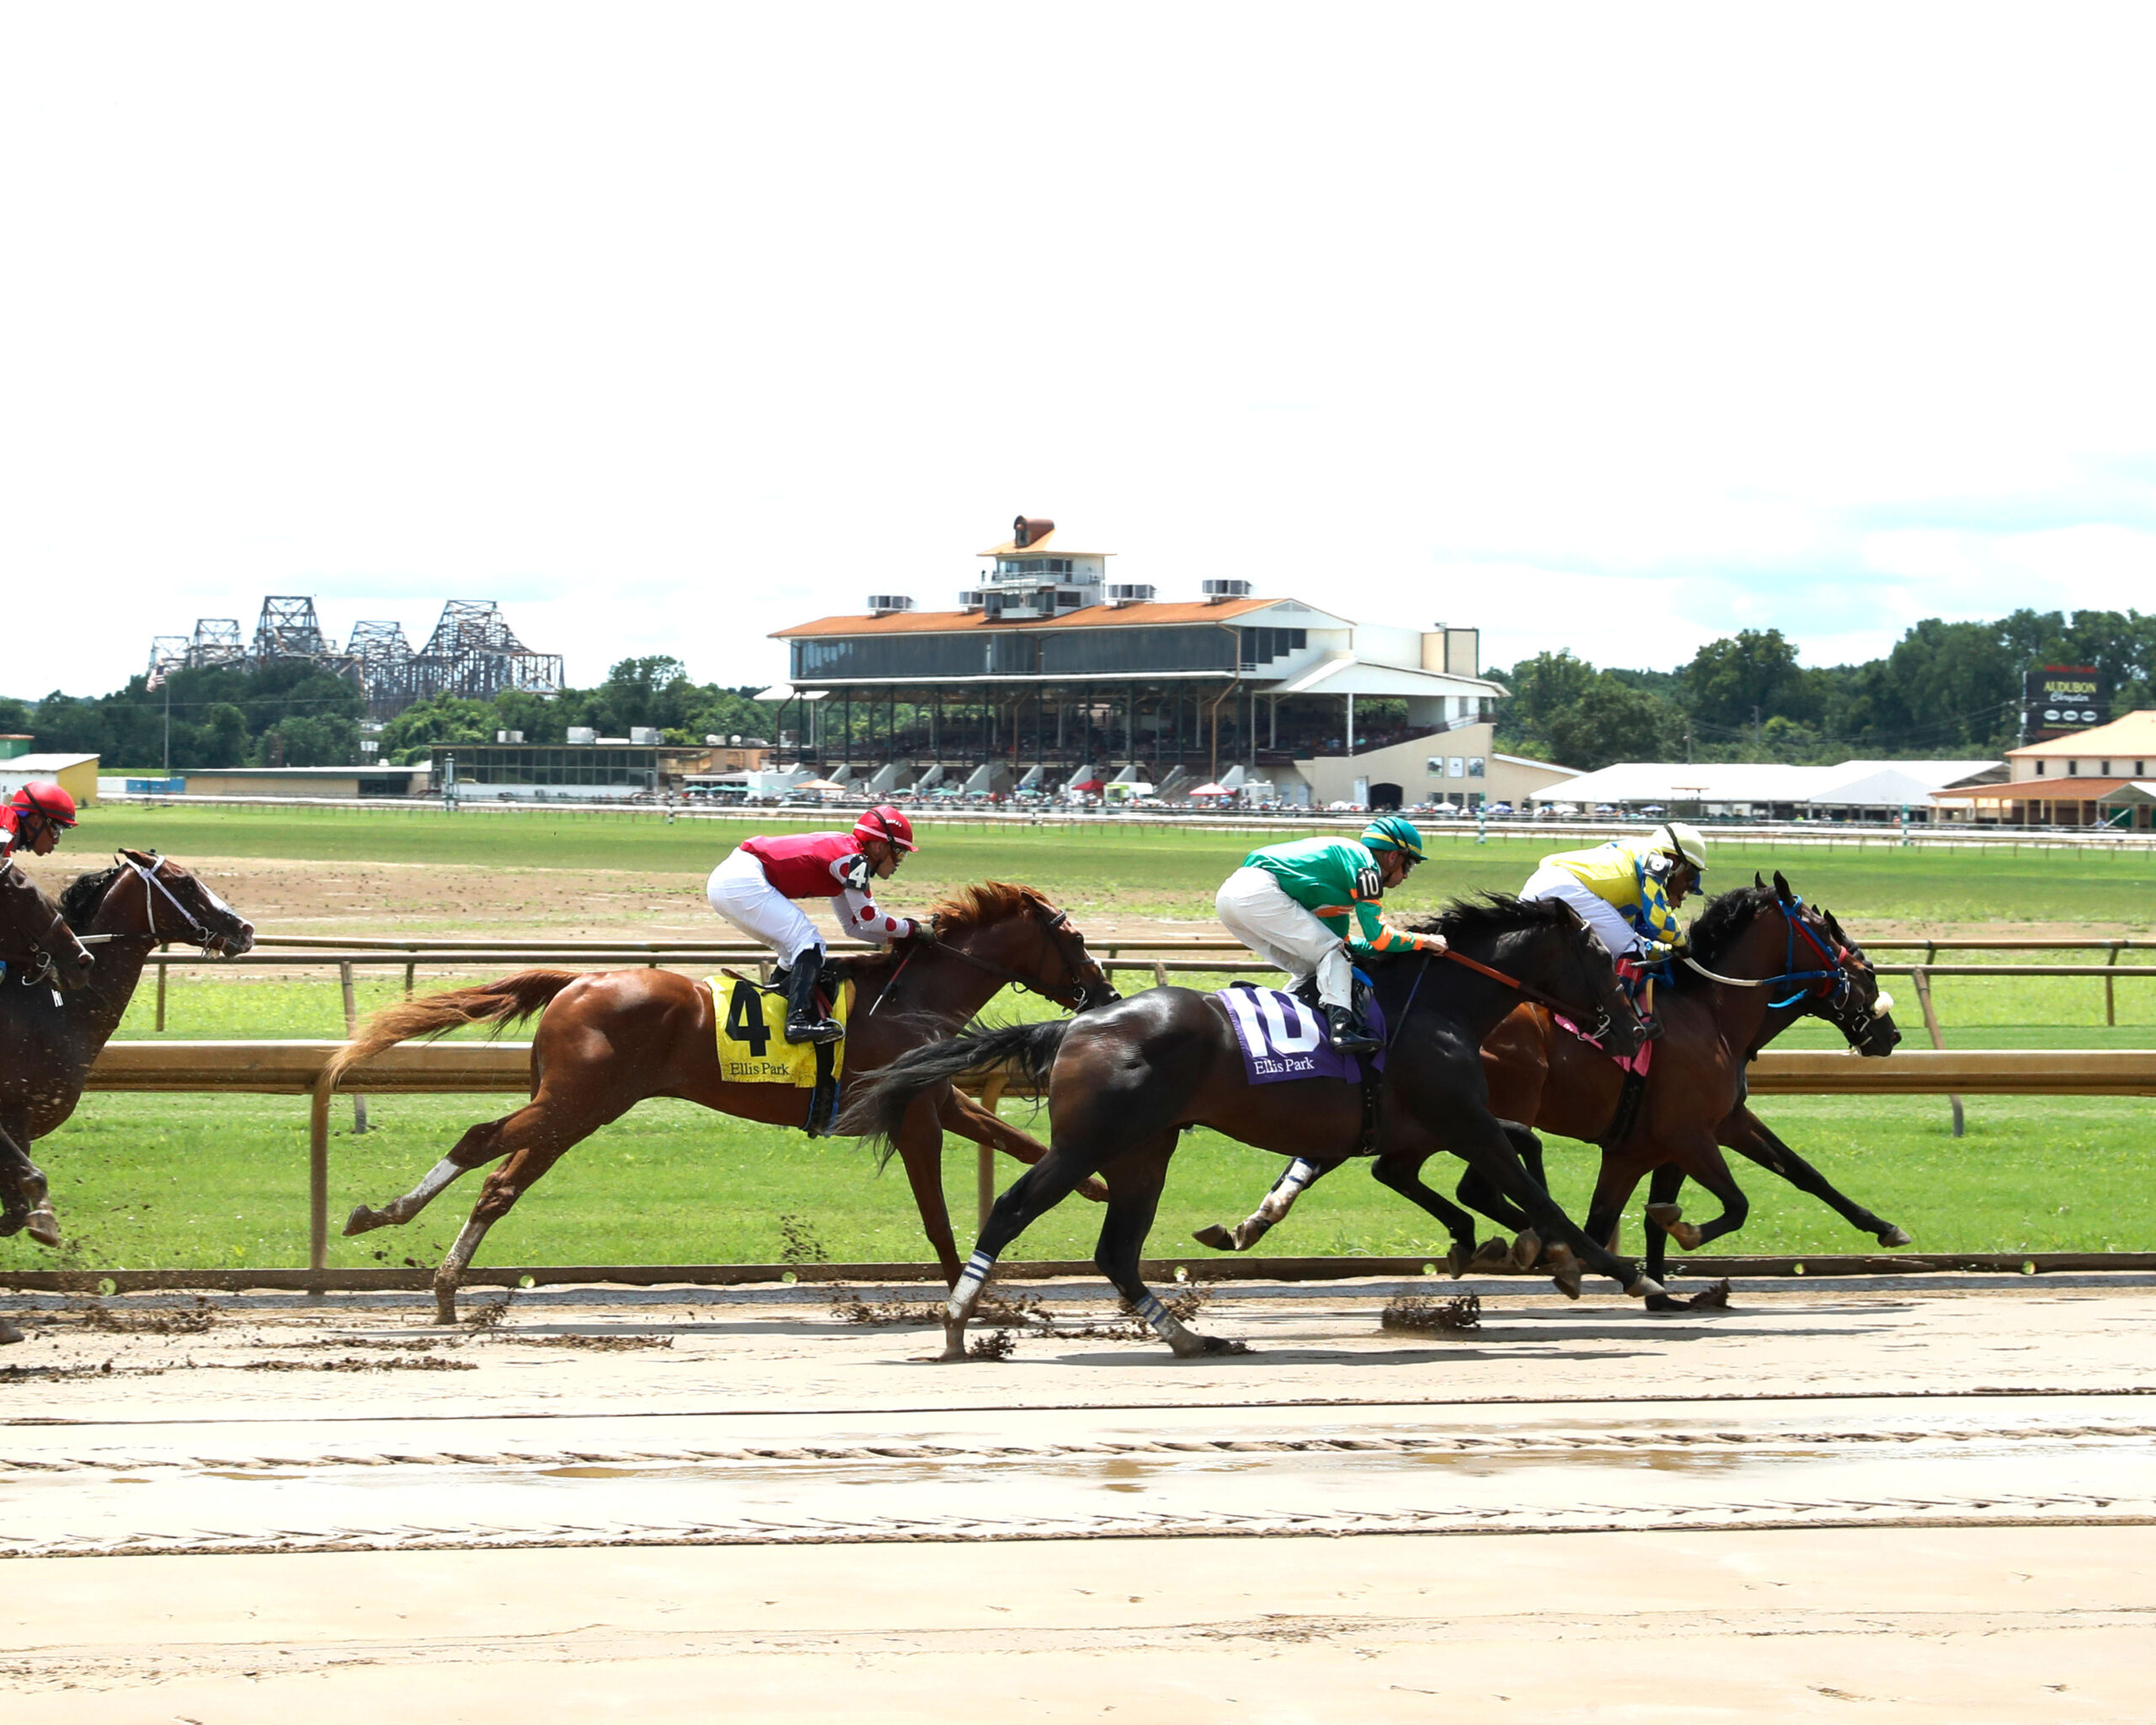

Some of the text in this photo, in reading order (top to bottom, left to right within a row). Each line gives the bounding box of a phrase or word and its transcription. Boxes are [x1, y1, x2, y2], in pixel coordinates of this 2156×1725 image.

[2043, 681, 2097, 693] AUDUBON
[848, 862, 867, 889] 4
[1359, 873, 1380, 896] 10
[725, 980, 771, 1057] 4
[1223, 986, 1321, 1058] 10
[729, 1062, 789, 1076] Ellis Park
[1254, 1056, 1315, 1076] Ellis Park
